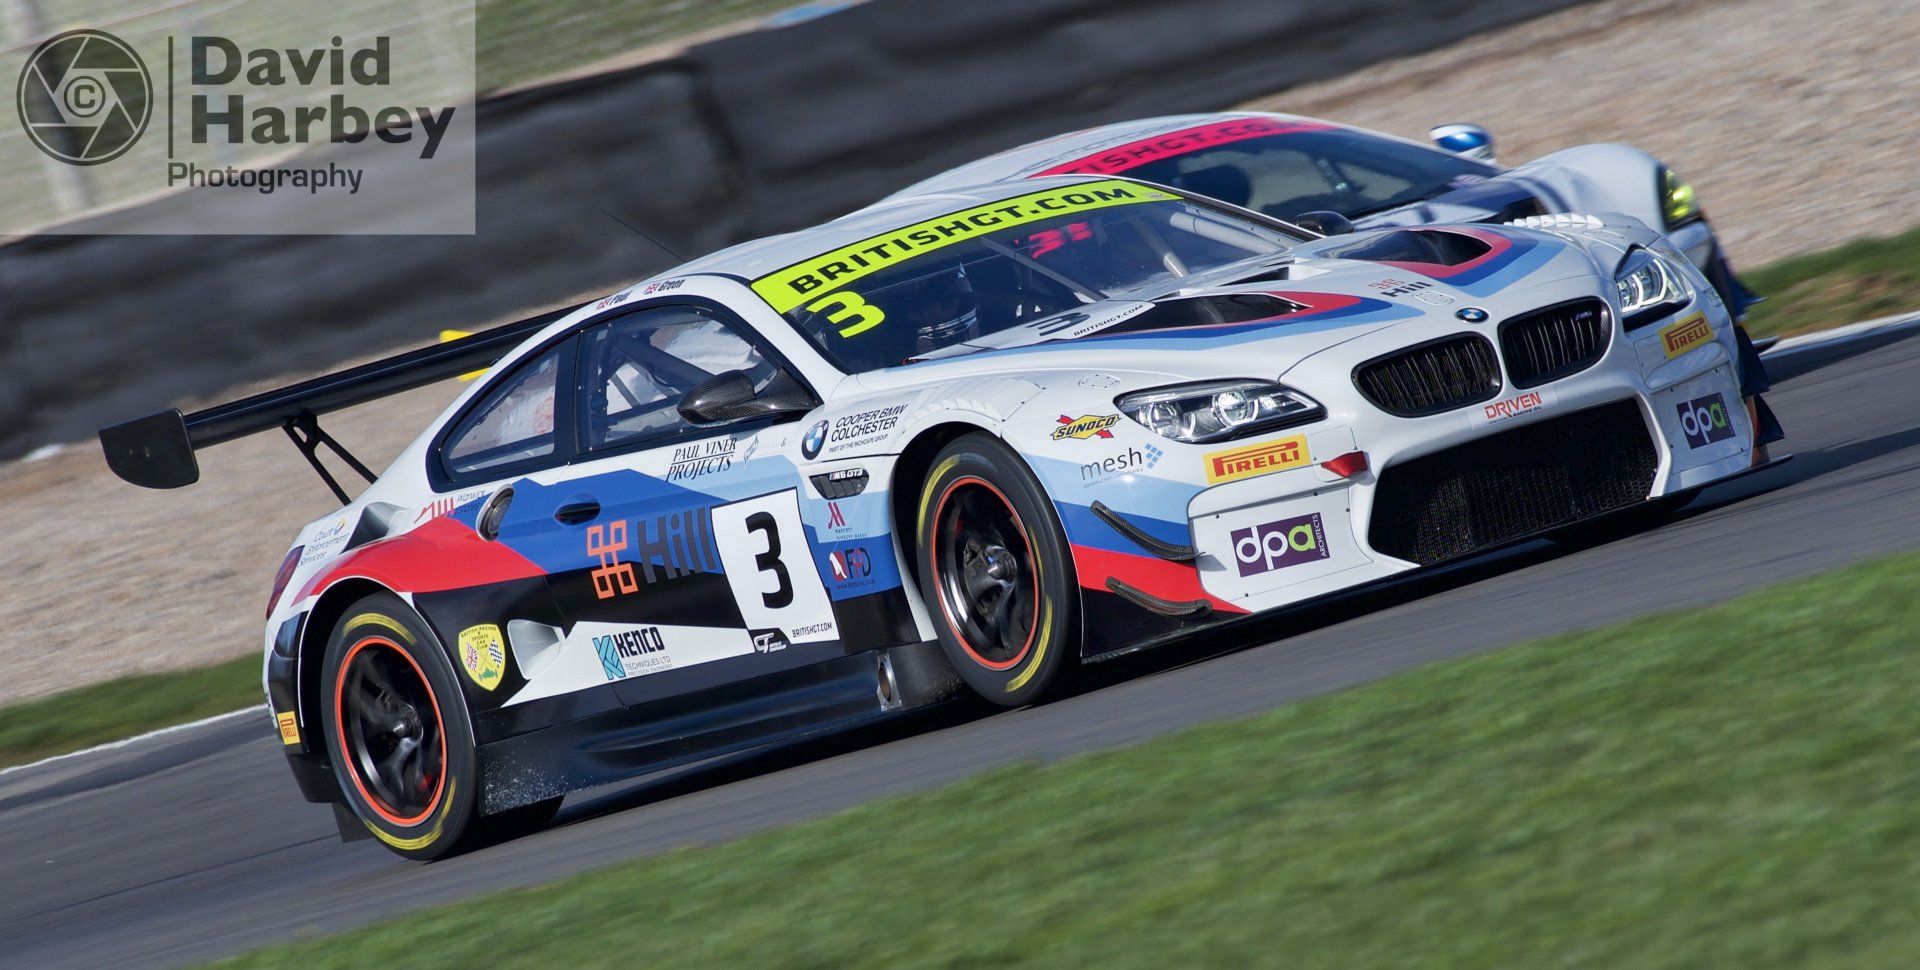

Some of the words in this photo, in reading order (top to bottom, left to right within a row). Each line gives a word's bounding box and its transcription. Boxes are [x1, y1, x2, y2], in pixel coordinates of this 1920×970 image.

[788, 187, 1137, 295] BRITISHGT.COM
[658, 280, 686, 292] Green
[1380, 281, 1433, 298] Hill
[804, 291, 886, 340] 3
[1025, 312, 1090, 337] 3
[1073, 304, 1143, 336] BRITISHGT.COM
[1664, 316, 1709, 352] PIRELLI
[836, 409, 880, 428] COOPER
[879, 403, 909, 419] BMW
[1484, 391, 1542, 419] DRIVEN
[831, 416, 898, 442] COLCHESTER
[1057, 416, 1116, 438] SUNOCO
[1682, 401, 1727, 444] dpa
[673, 444, 700, 461] PAUL
[706, 437, 737, 454] VINER
[1080, 447, 1143, 480] mesh
[1212, 441, 1300, 477] PIRELLI
[666, 454, 733, 482] PROJECTS
[847, 469, 864, 478] GT3
[636, 506, 717, 584] Hill
[1236, 525, 1316, 571] dpa
[1312, 513, 1327, 558] ARCHITECTS
[745, 511, 794, 609] 3
[613, 627, 665, 658] KENCO
[792, 621, 833, 638] BRITISHGT.COM
